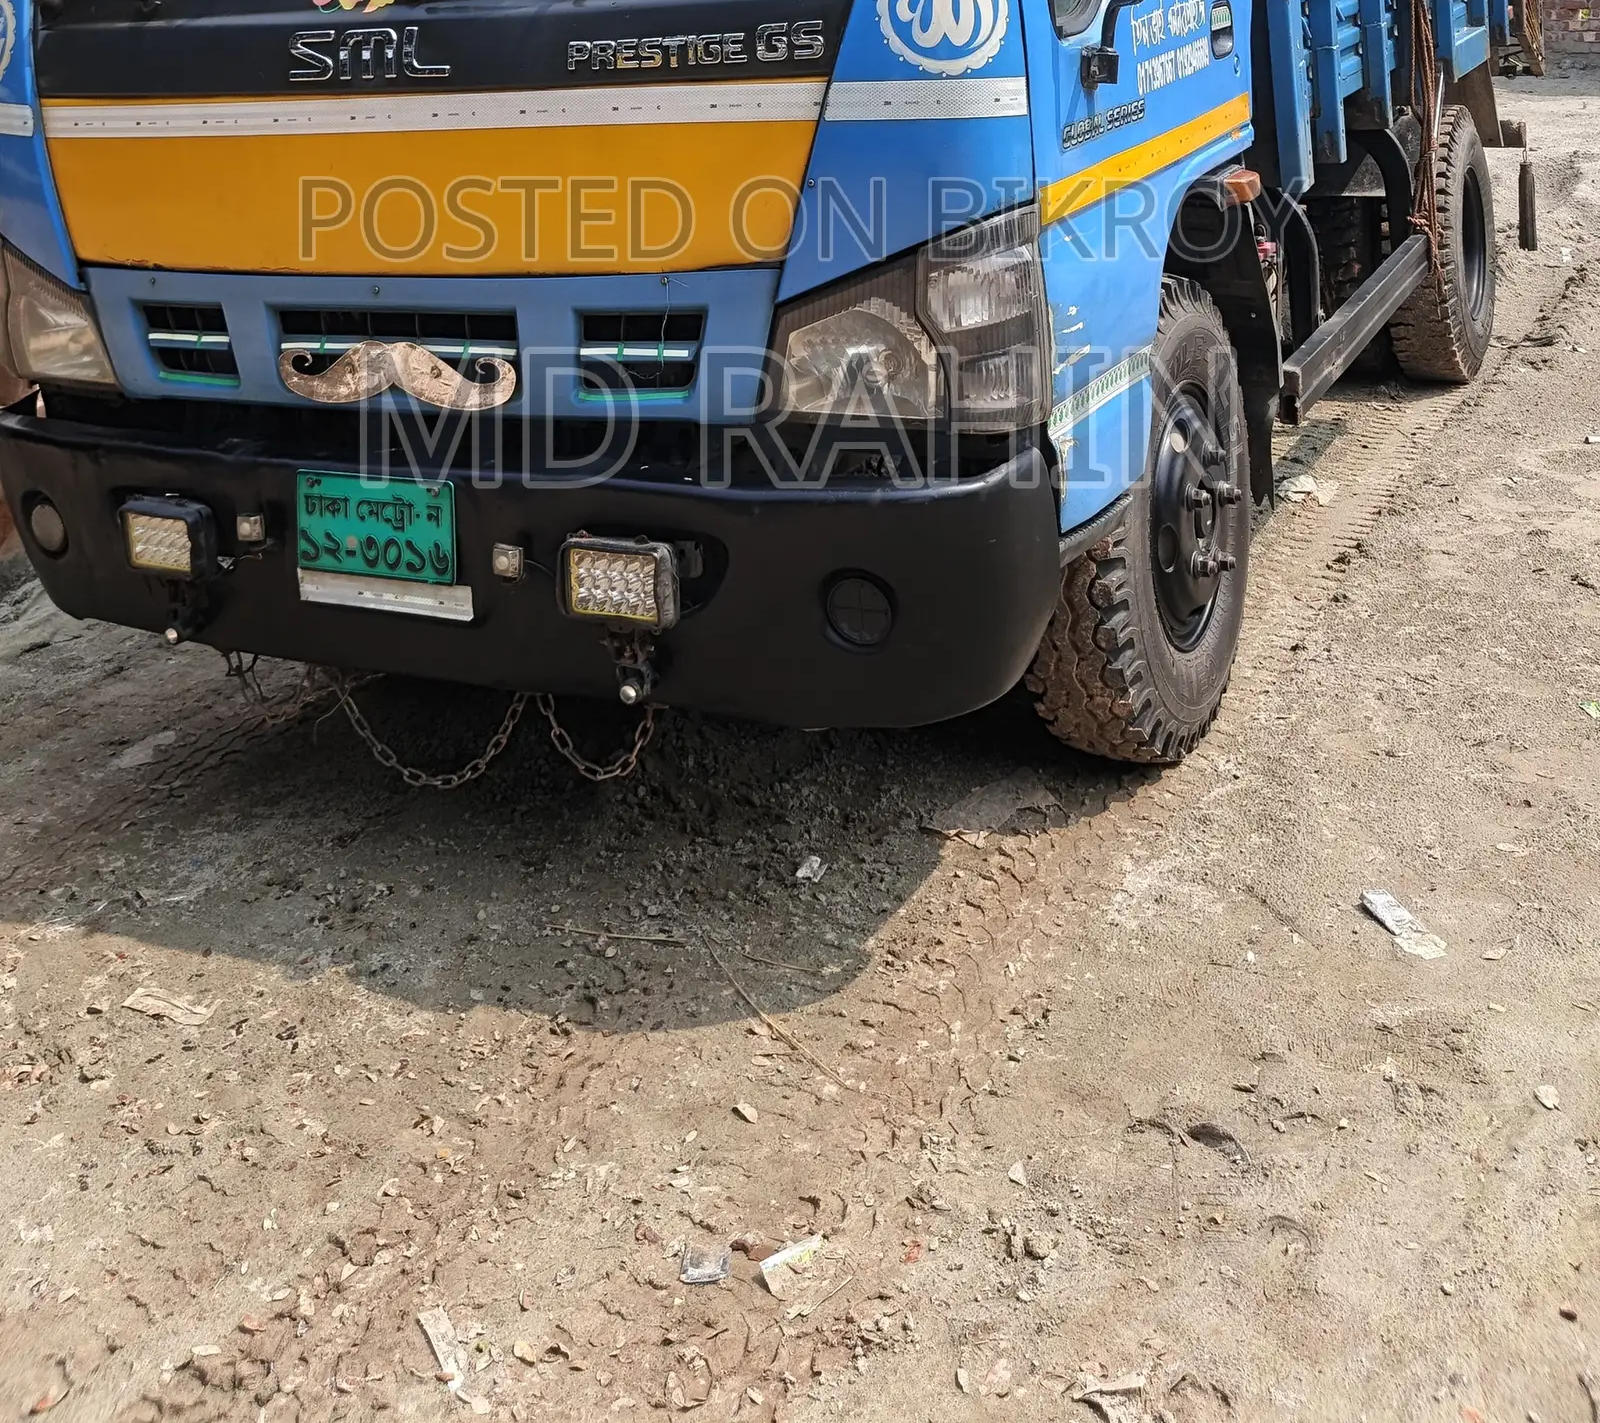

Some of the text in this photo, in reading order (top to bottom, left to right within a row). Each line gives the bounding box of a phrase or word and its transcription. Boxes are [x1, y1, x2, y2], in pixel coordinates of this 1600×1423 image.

[289, 26, 451, 82] SML
[566, 20, 825, 71] PRESTIGE GS
[304, 493, 350, 520] ঢাকা
[300, 527, 451, 577] ১২-৩০১৬
